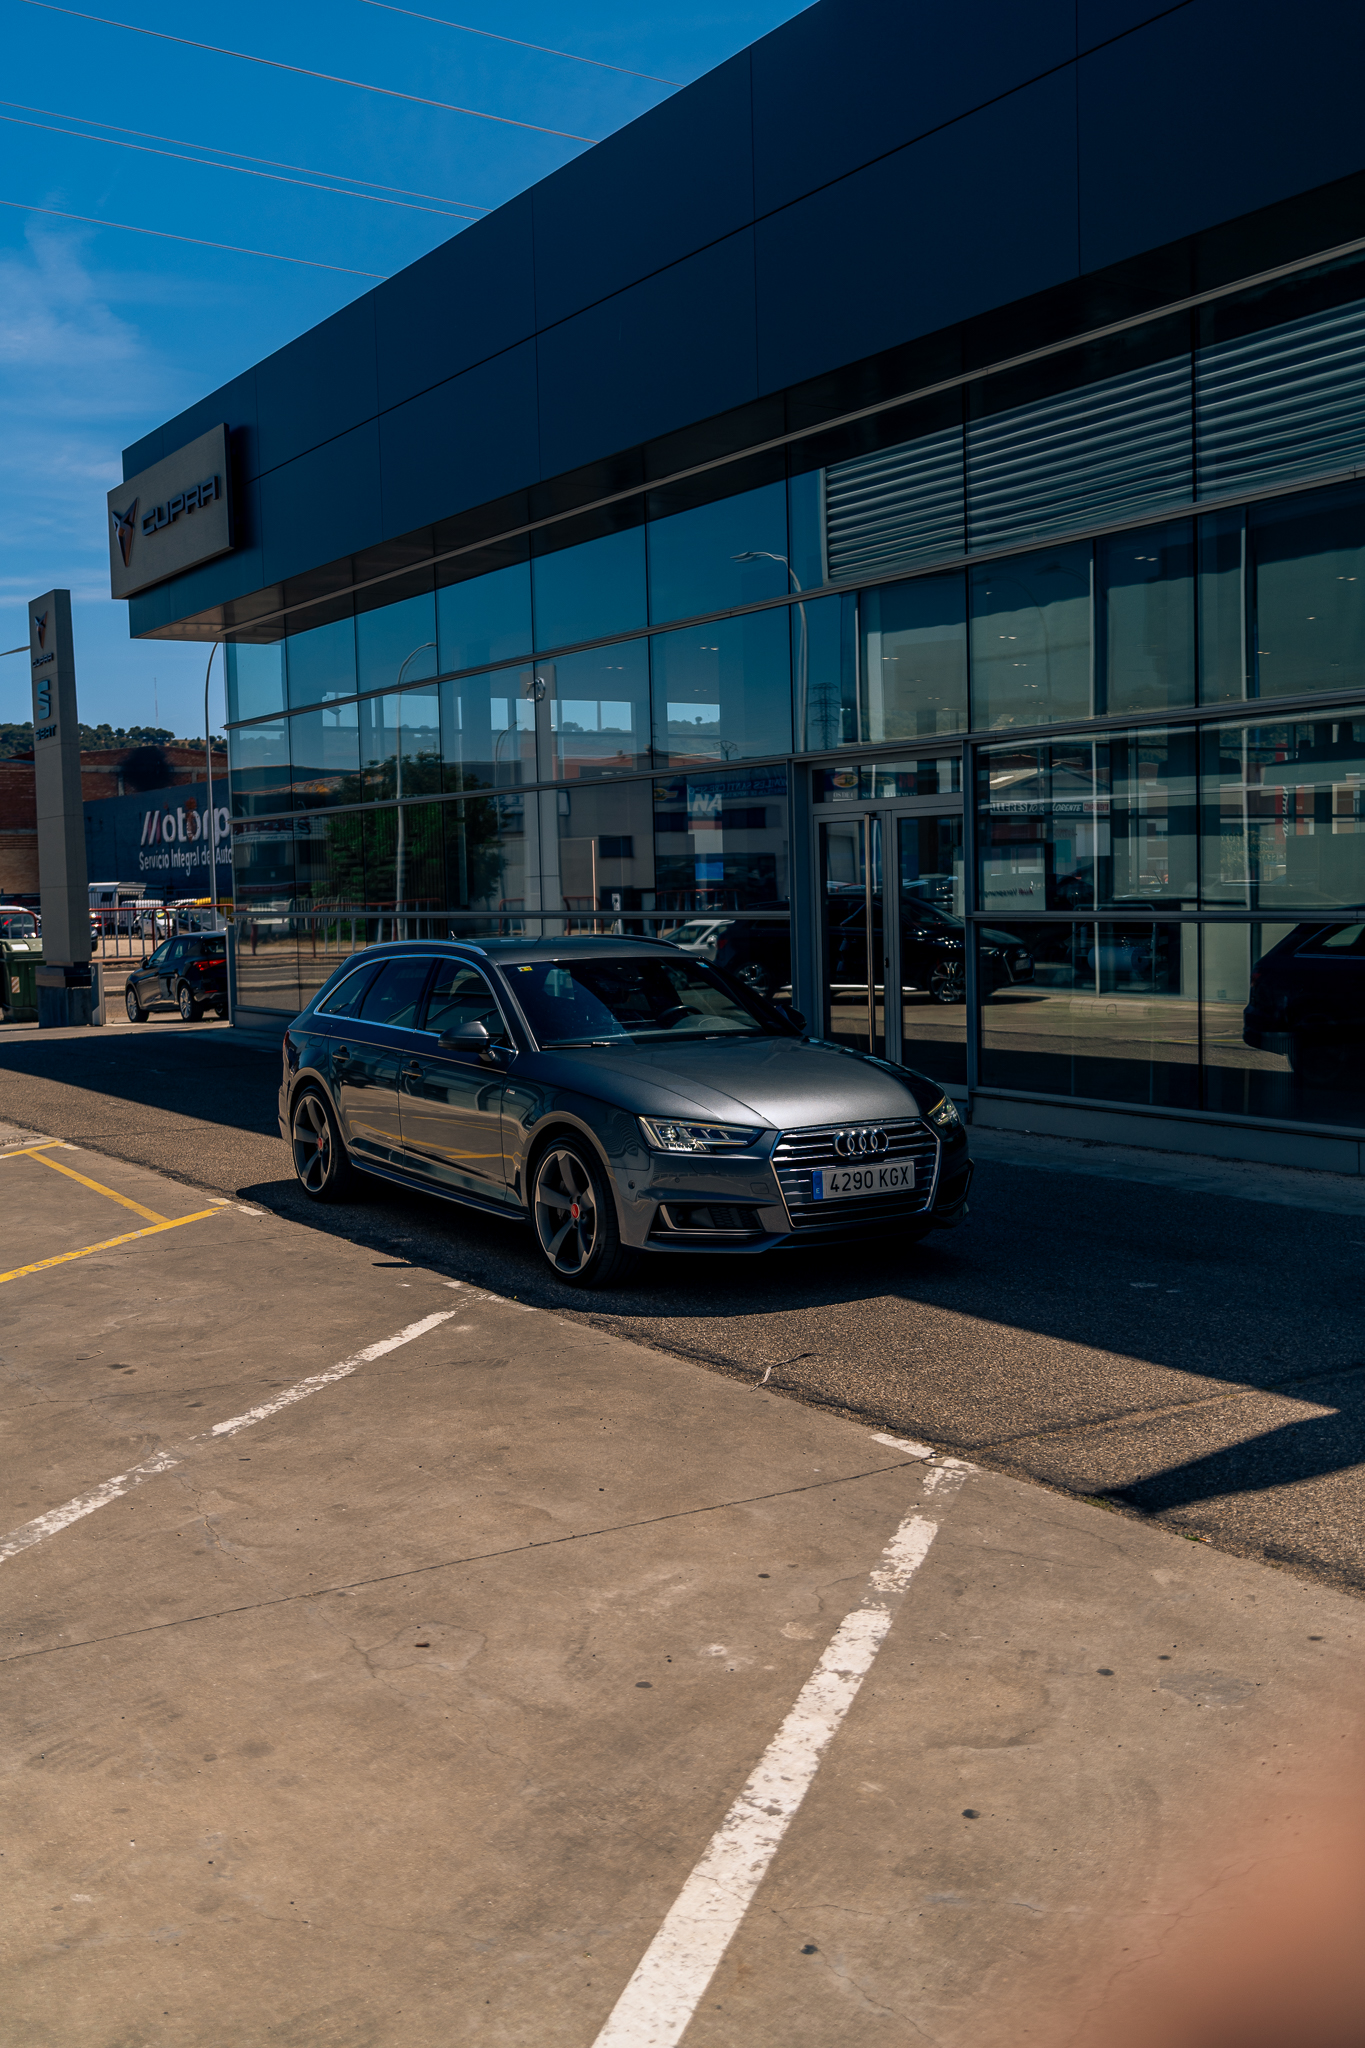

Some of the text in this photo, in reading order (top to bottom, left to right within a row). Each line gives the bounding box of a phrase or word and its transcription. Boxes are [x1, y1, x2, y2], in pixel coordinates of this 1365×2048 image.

[141, 475, 219, 536] CUPRA
[32, 652, 54, 668] CUPRA
[35, 724, 57, 741] SEAT
[139, 848, 170, 871] Servicio
[171, 845, 200, 877] Integral
[830, 1166, 909, 1192] 4290 KGX
